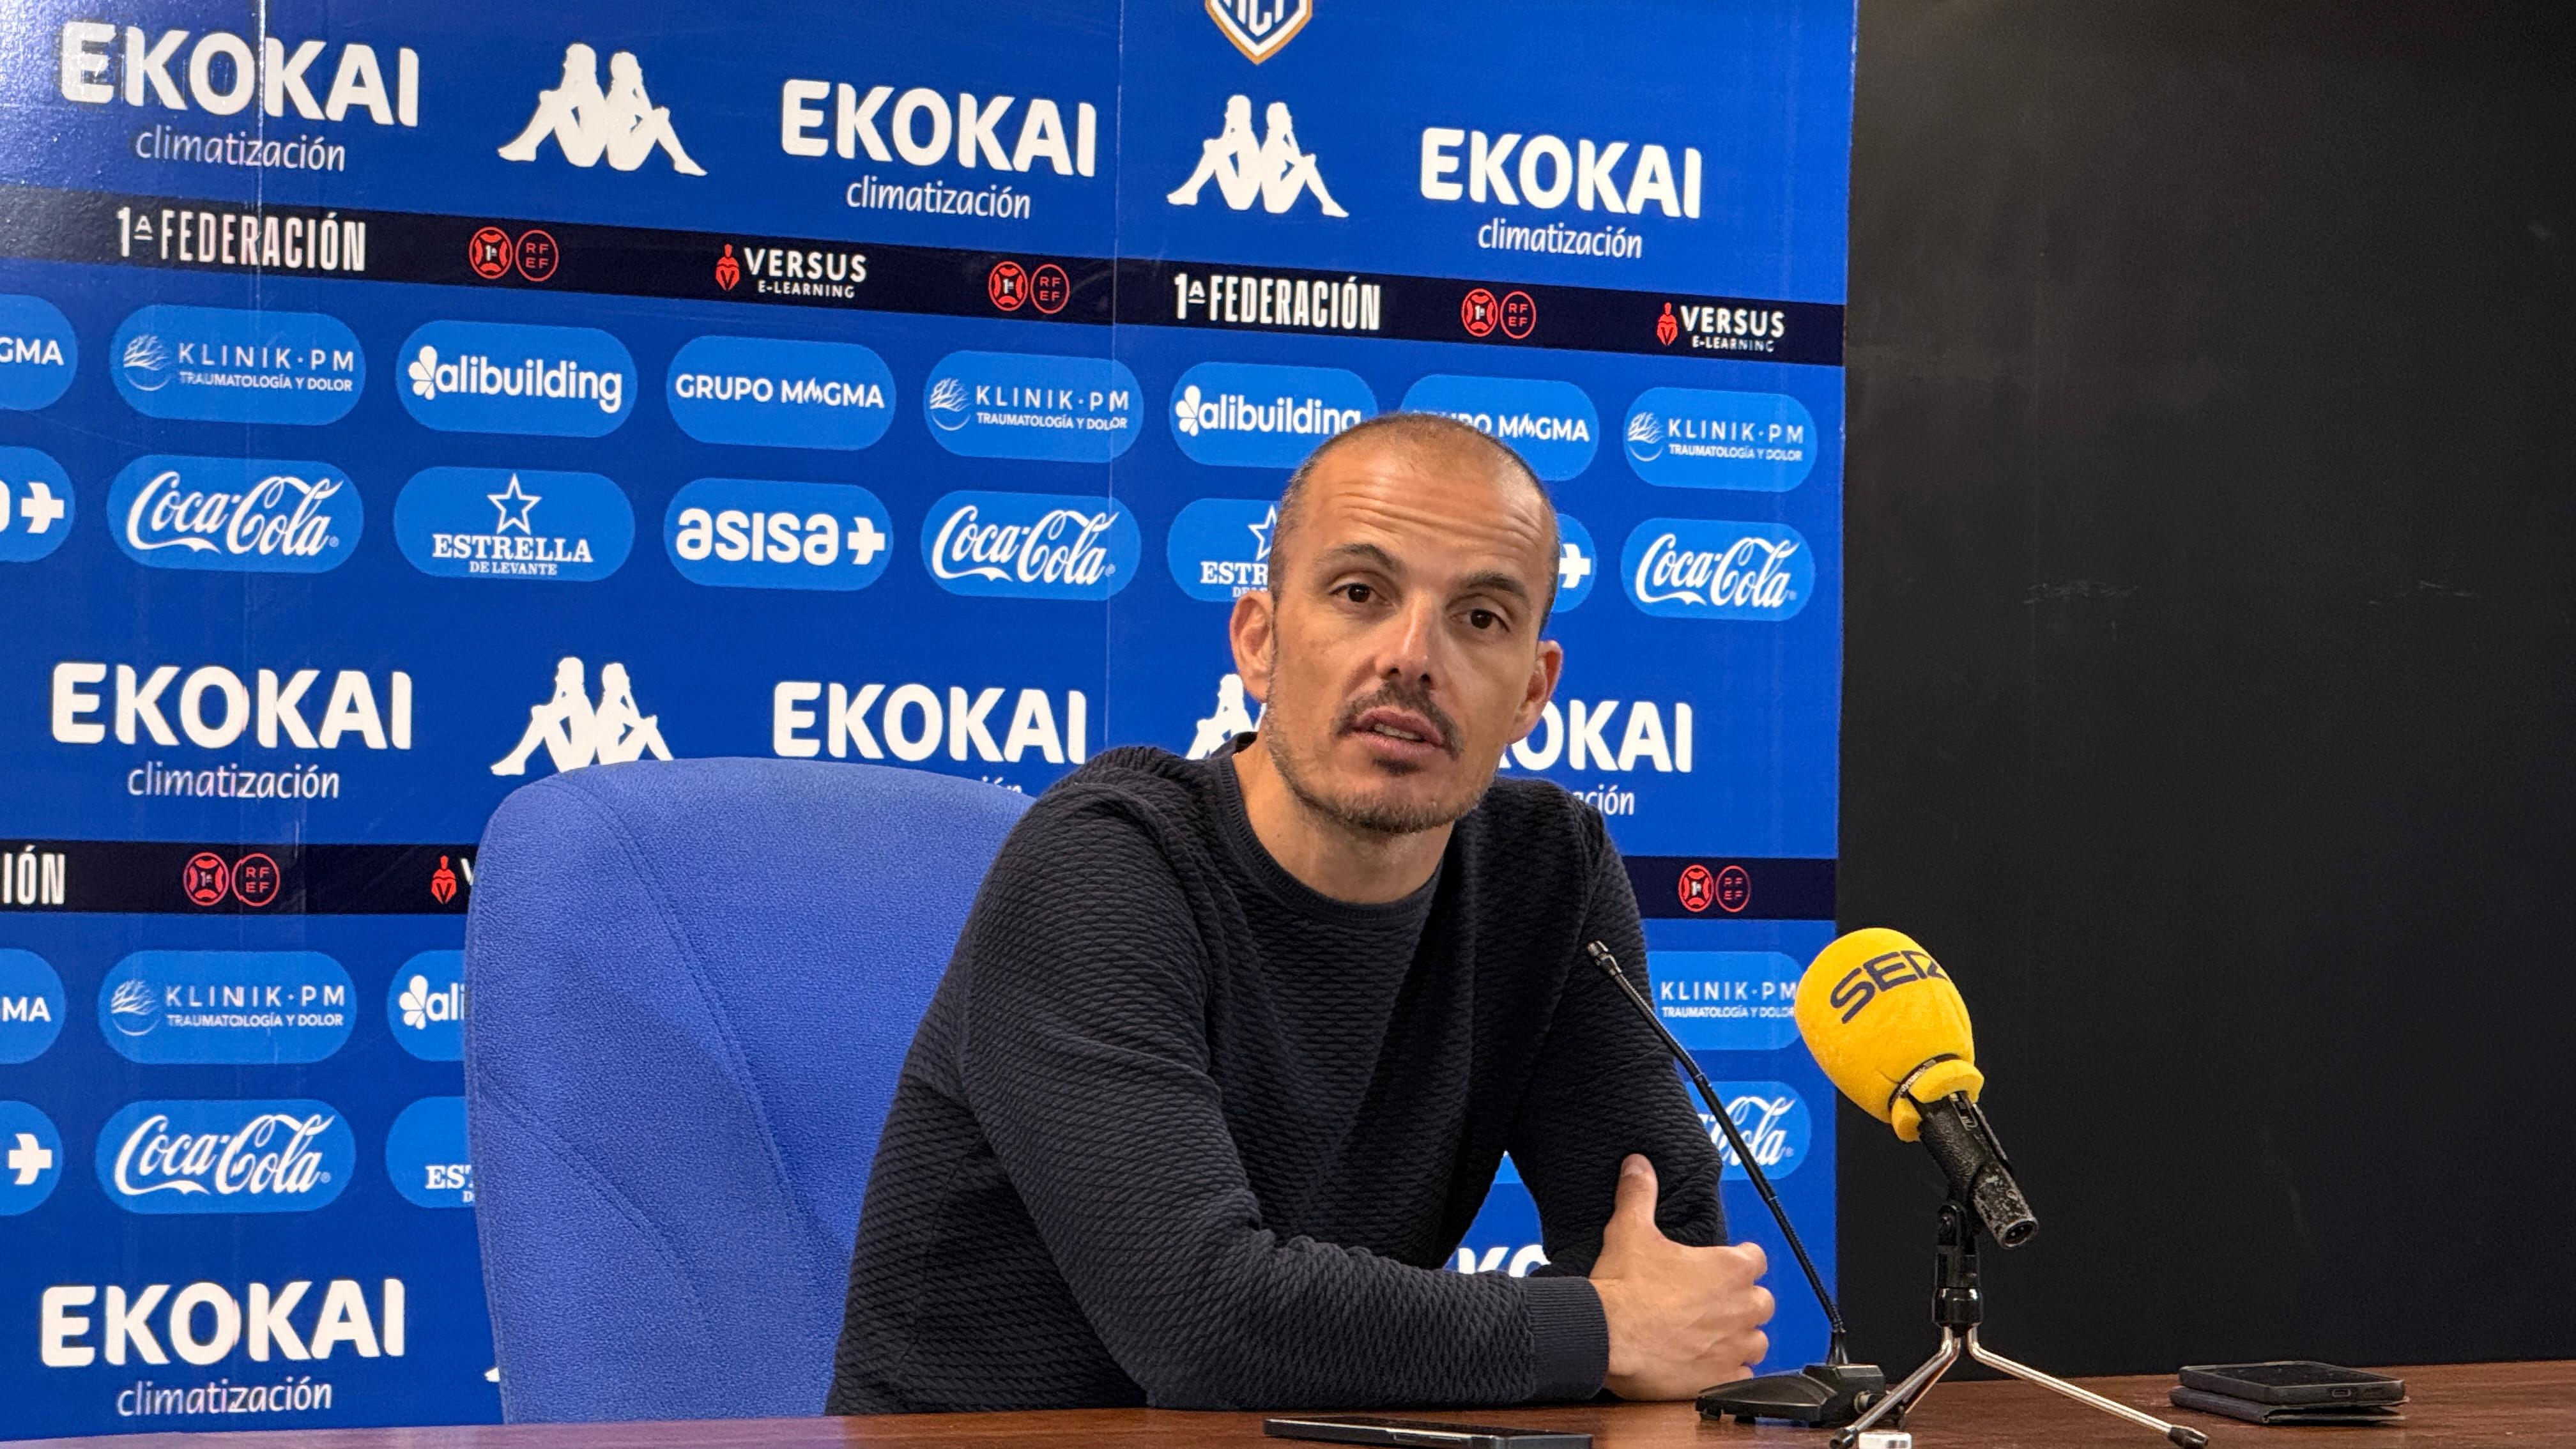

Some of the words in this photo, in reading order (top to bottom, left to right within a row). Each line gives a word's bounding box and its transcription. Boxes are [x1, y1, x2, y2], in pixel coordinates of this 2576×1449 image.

[59, 20, 419, 128] EKOKAI
[135, 126, 346, 172] climatización
[781, 79, 1096, 178] EKOKAI
[1420, 127, 1702, 220] EKOKAI
[847, 176, 1030, 218] climatización
[162, 210, 365, 271] FEDERACIÓN
[1478, 217, 1643, 259] climatización
[744, 247, 867, 282] VERSUS
[758, 279, 855, 298] E-LEARNING
[1210, 275, 1380, 330] FEDERACIÓN
[1680, 305, 1785, 338] VERSUS
[1692, 335, 1774, 352] E-LEARNING
[179, 371, 293, 389] TRAUMATOLOGÍA
[295, 378, 305, 390] Y
[307, 378, 353, 392] DOLOR
[437, 354, 622, 413] alibuilding
[676, 374, 773, 401] GRUPO
[977, 413, 1073, 427] TRAUMATOLOGÍA
[1076, 417, 1085, 429] Y
[1087, 417, 1127, 430] DOLOR
[1668, 443, 1755, 459] TRAUMATOLOGÍA
[1757, 448, 1765, 459] Y
[1766, 449, 1803, 461] DOLOR
[127, 471, 344, 556] Coca-Cola
[432, 533, 594, 563] ESTRELLA
[933, 505, 1117, 585] Coca-Cola
[469, 560, 489, 573] DE
[491, 562, 558, 576] LEVANTE
[1636, 533, 1801, 608] Coca-Cola
[52, 663, 411, 749] EKOKAI
[774, 682, 1086, 764] EKOKAI
[129, 762, 339, 798] climatización
[167, 1013, 282, 1027] TRAUMATOLOGÍA
[286, 1015, 296, 1026] Y
[298, 1014, 342, 1026] DOLOR
[1662, 1005, 1748, 1018] TRAUMATOLOGÍA
[1750, 1006, 1758, 1018] Y
[115, 1114, 333, 1195] Coca-Cola
[42, 1279, 404, 1367] EKOKAI
[118, 1376, 331, 1416] climatización
